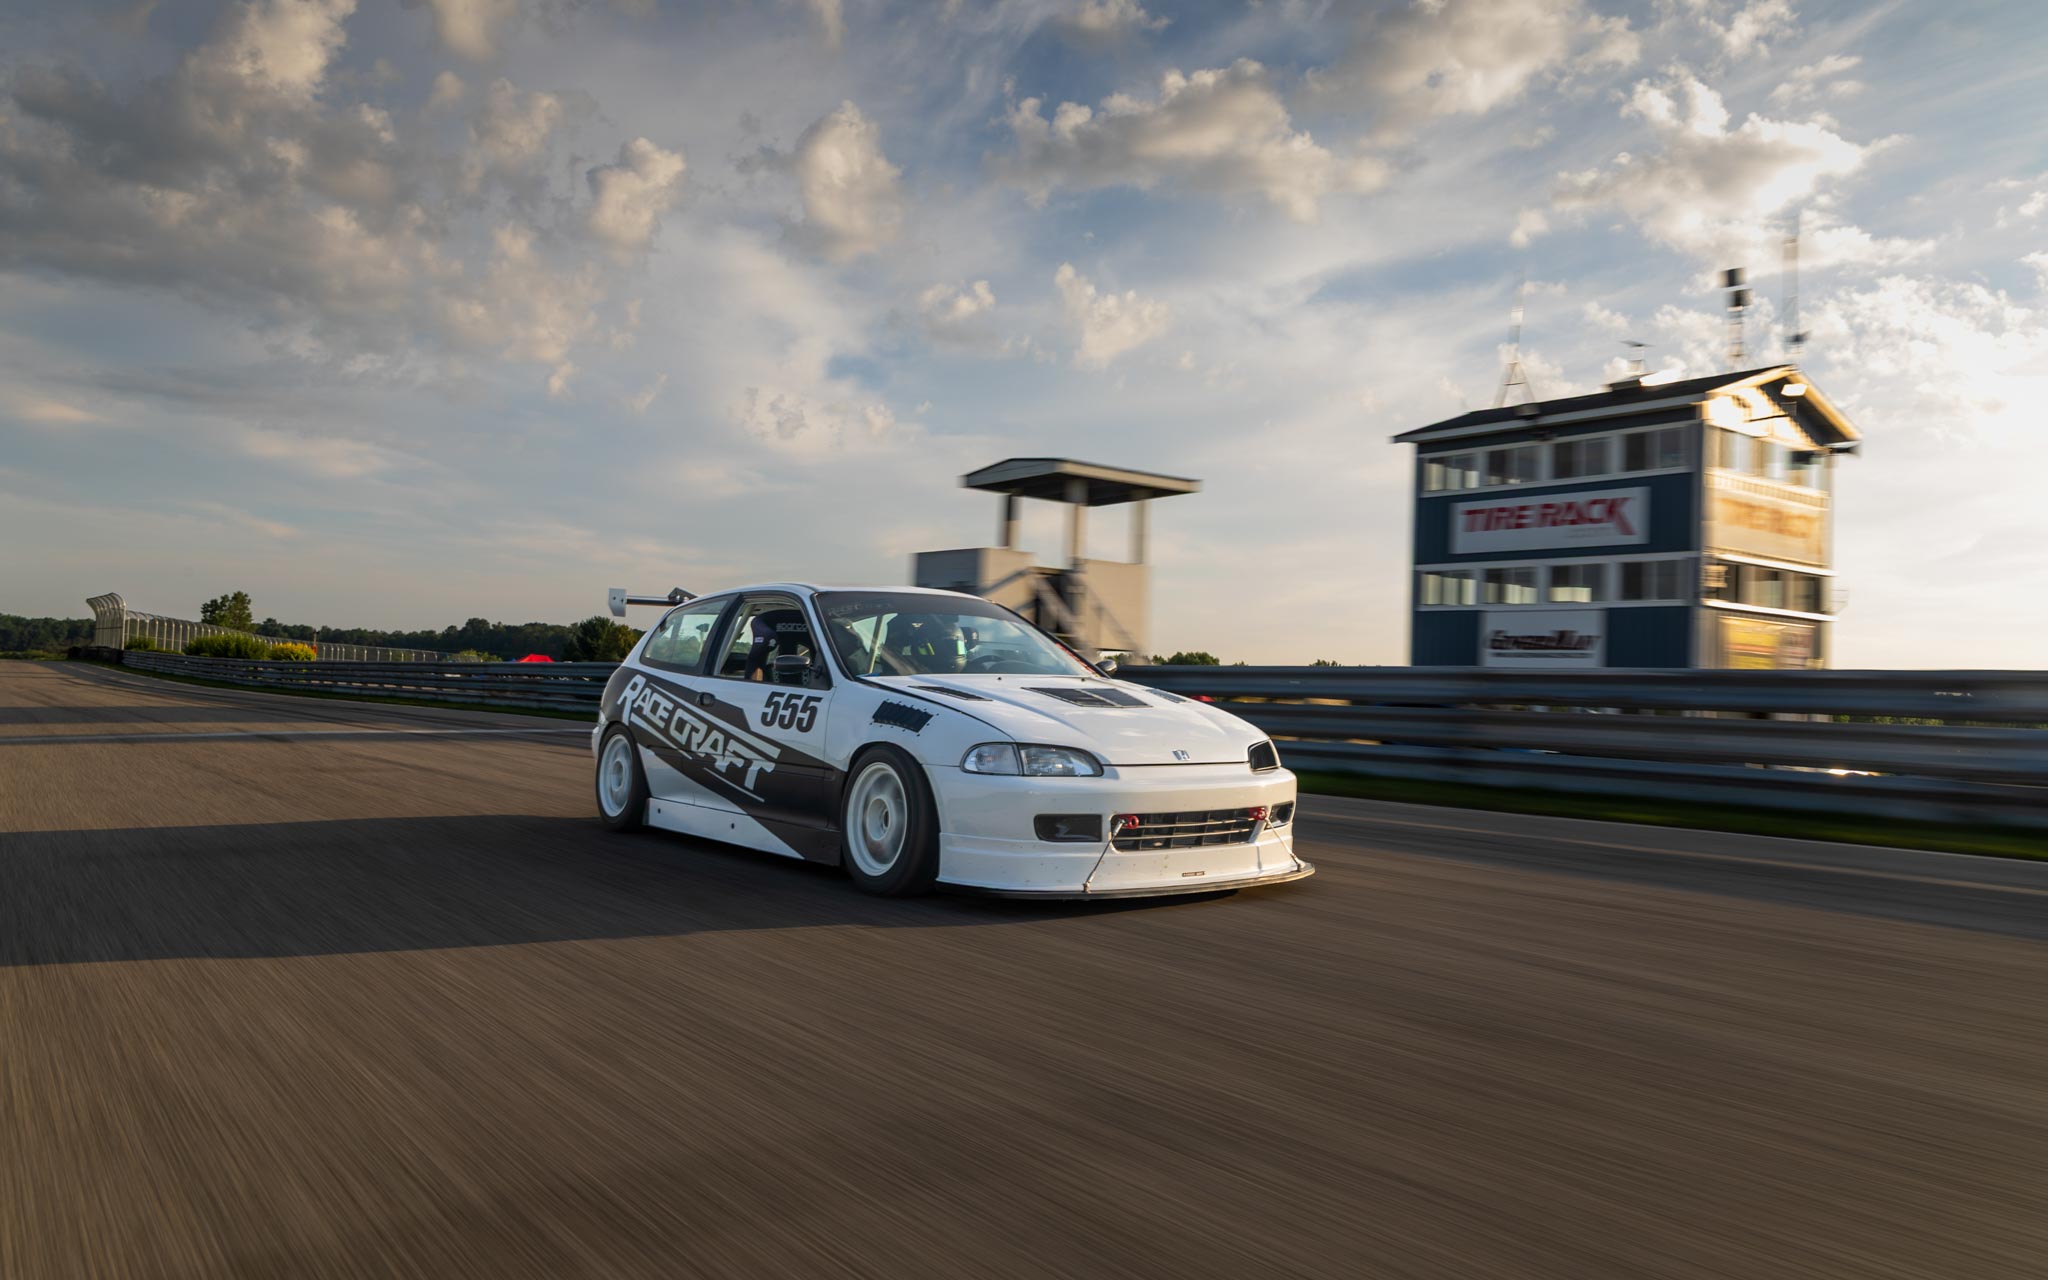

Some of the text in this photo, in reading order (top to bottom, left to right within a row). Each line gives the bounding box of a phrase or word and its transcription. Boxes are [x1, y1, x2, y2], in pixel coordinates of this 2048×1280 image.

[1462, 497, 1636, 536] TIRE RACK
[761, 690, 823, 733] 555
